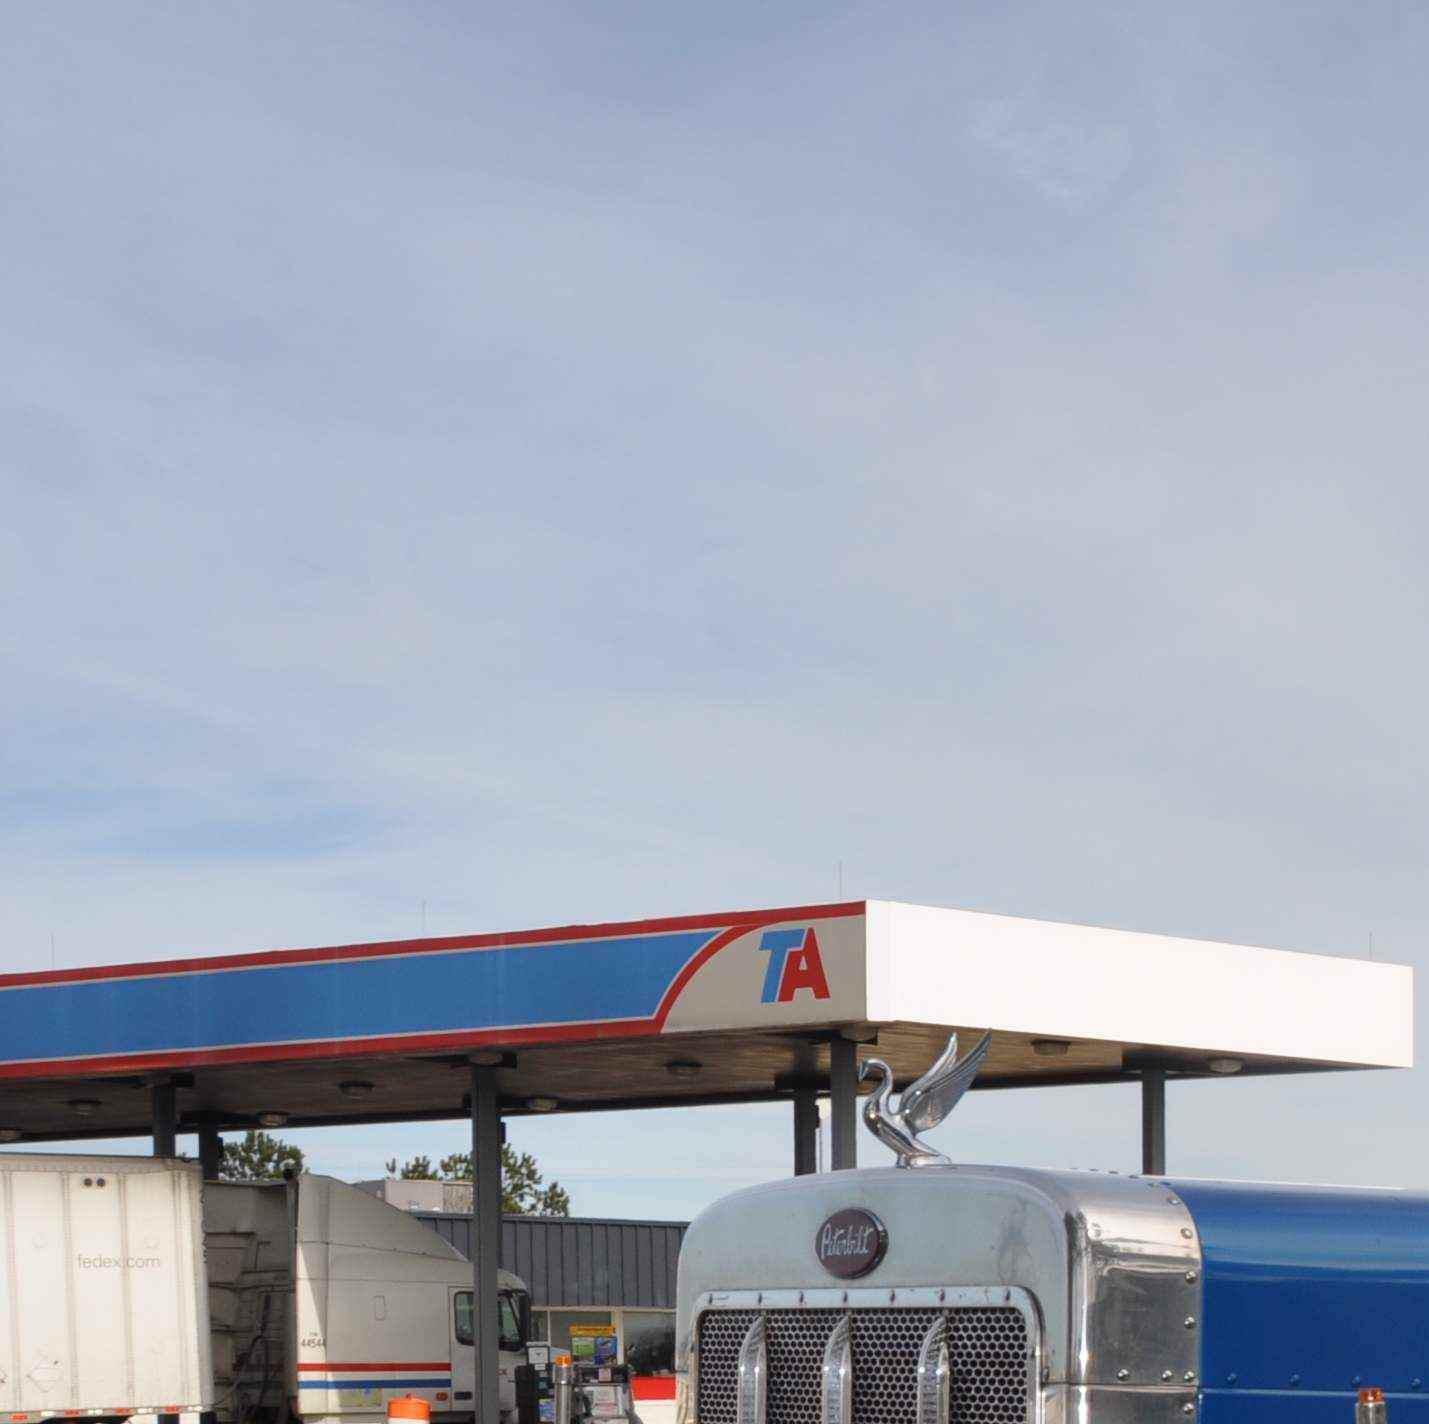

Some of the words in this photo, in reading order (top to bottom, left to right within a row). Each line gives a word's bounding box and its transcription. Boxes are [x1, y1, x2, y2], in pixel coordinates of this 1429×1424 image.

[758, 927, 831, 1003] TA
[821, 1223, 875, 1260] Peterbilt
[77, 1253, 161, 1269] fedex.com
